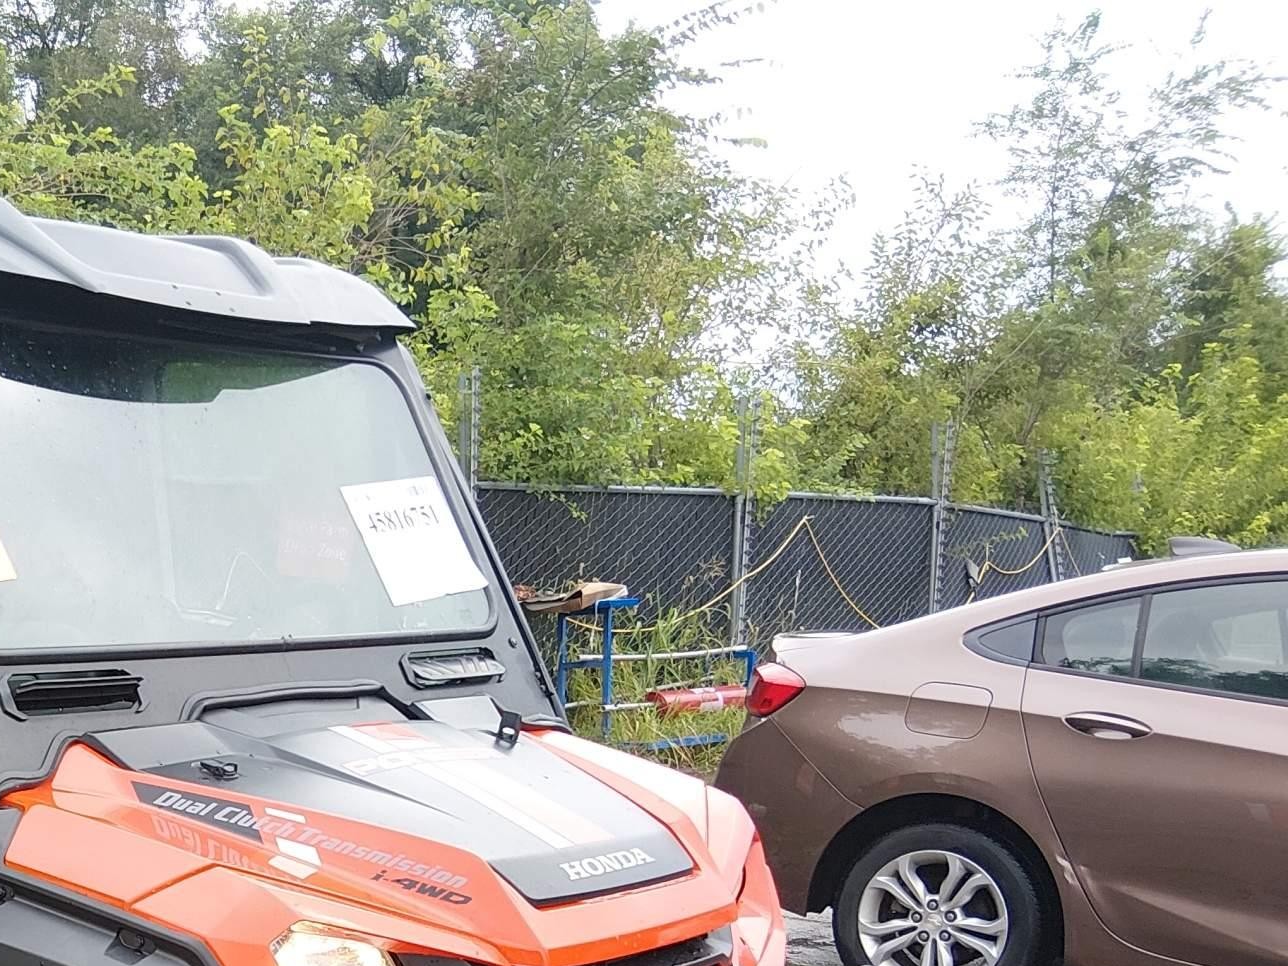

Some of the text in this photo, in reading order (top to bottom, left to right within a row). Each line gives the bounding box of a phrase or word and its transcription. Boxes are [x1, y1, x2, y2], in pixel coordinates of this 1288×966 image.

[153, 790, 469, 889] Dual Clutch Transmission
[560, 848, 656, 880] HONDA
[371, 870, 473, 905] i-4WD
